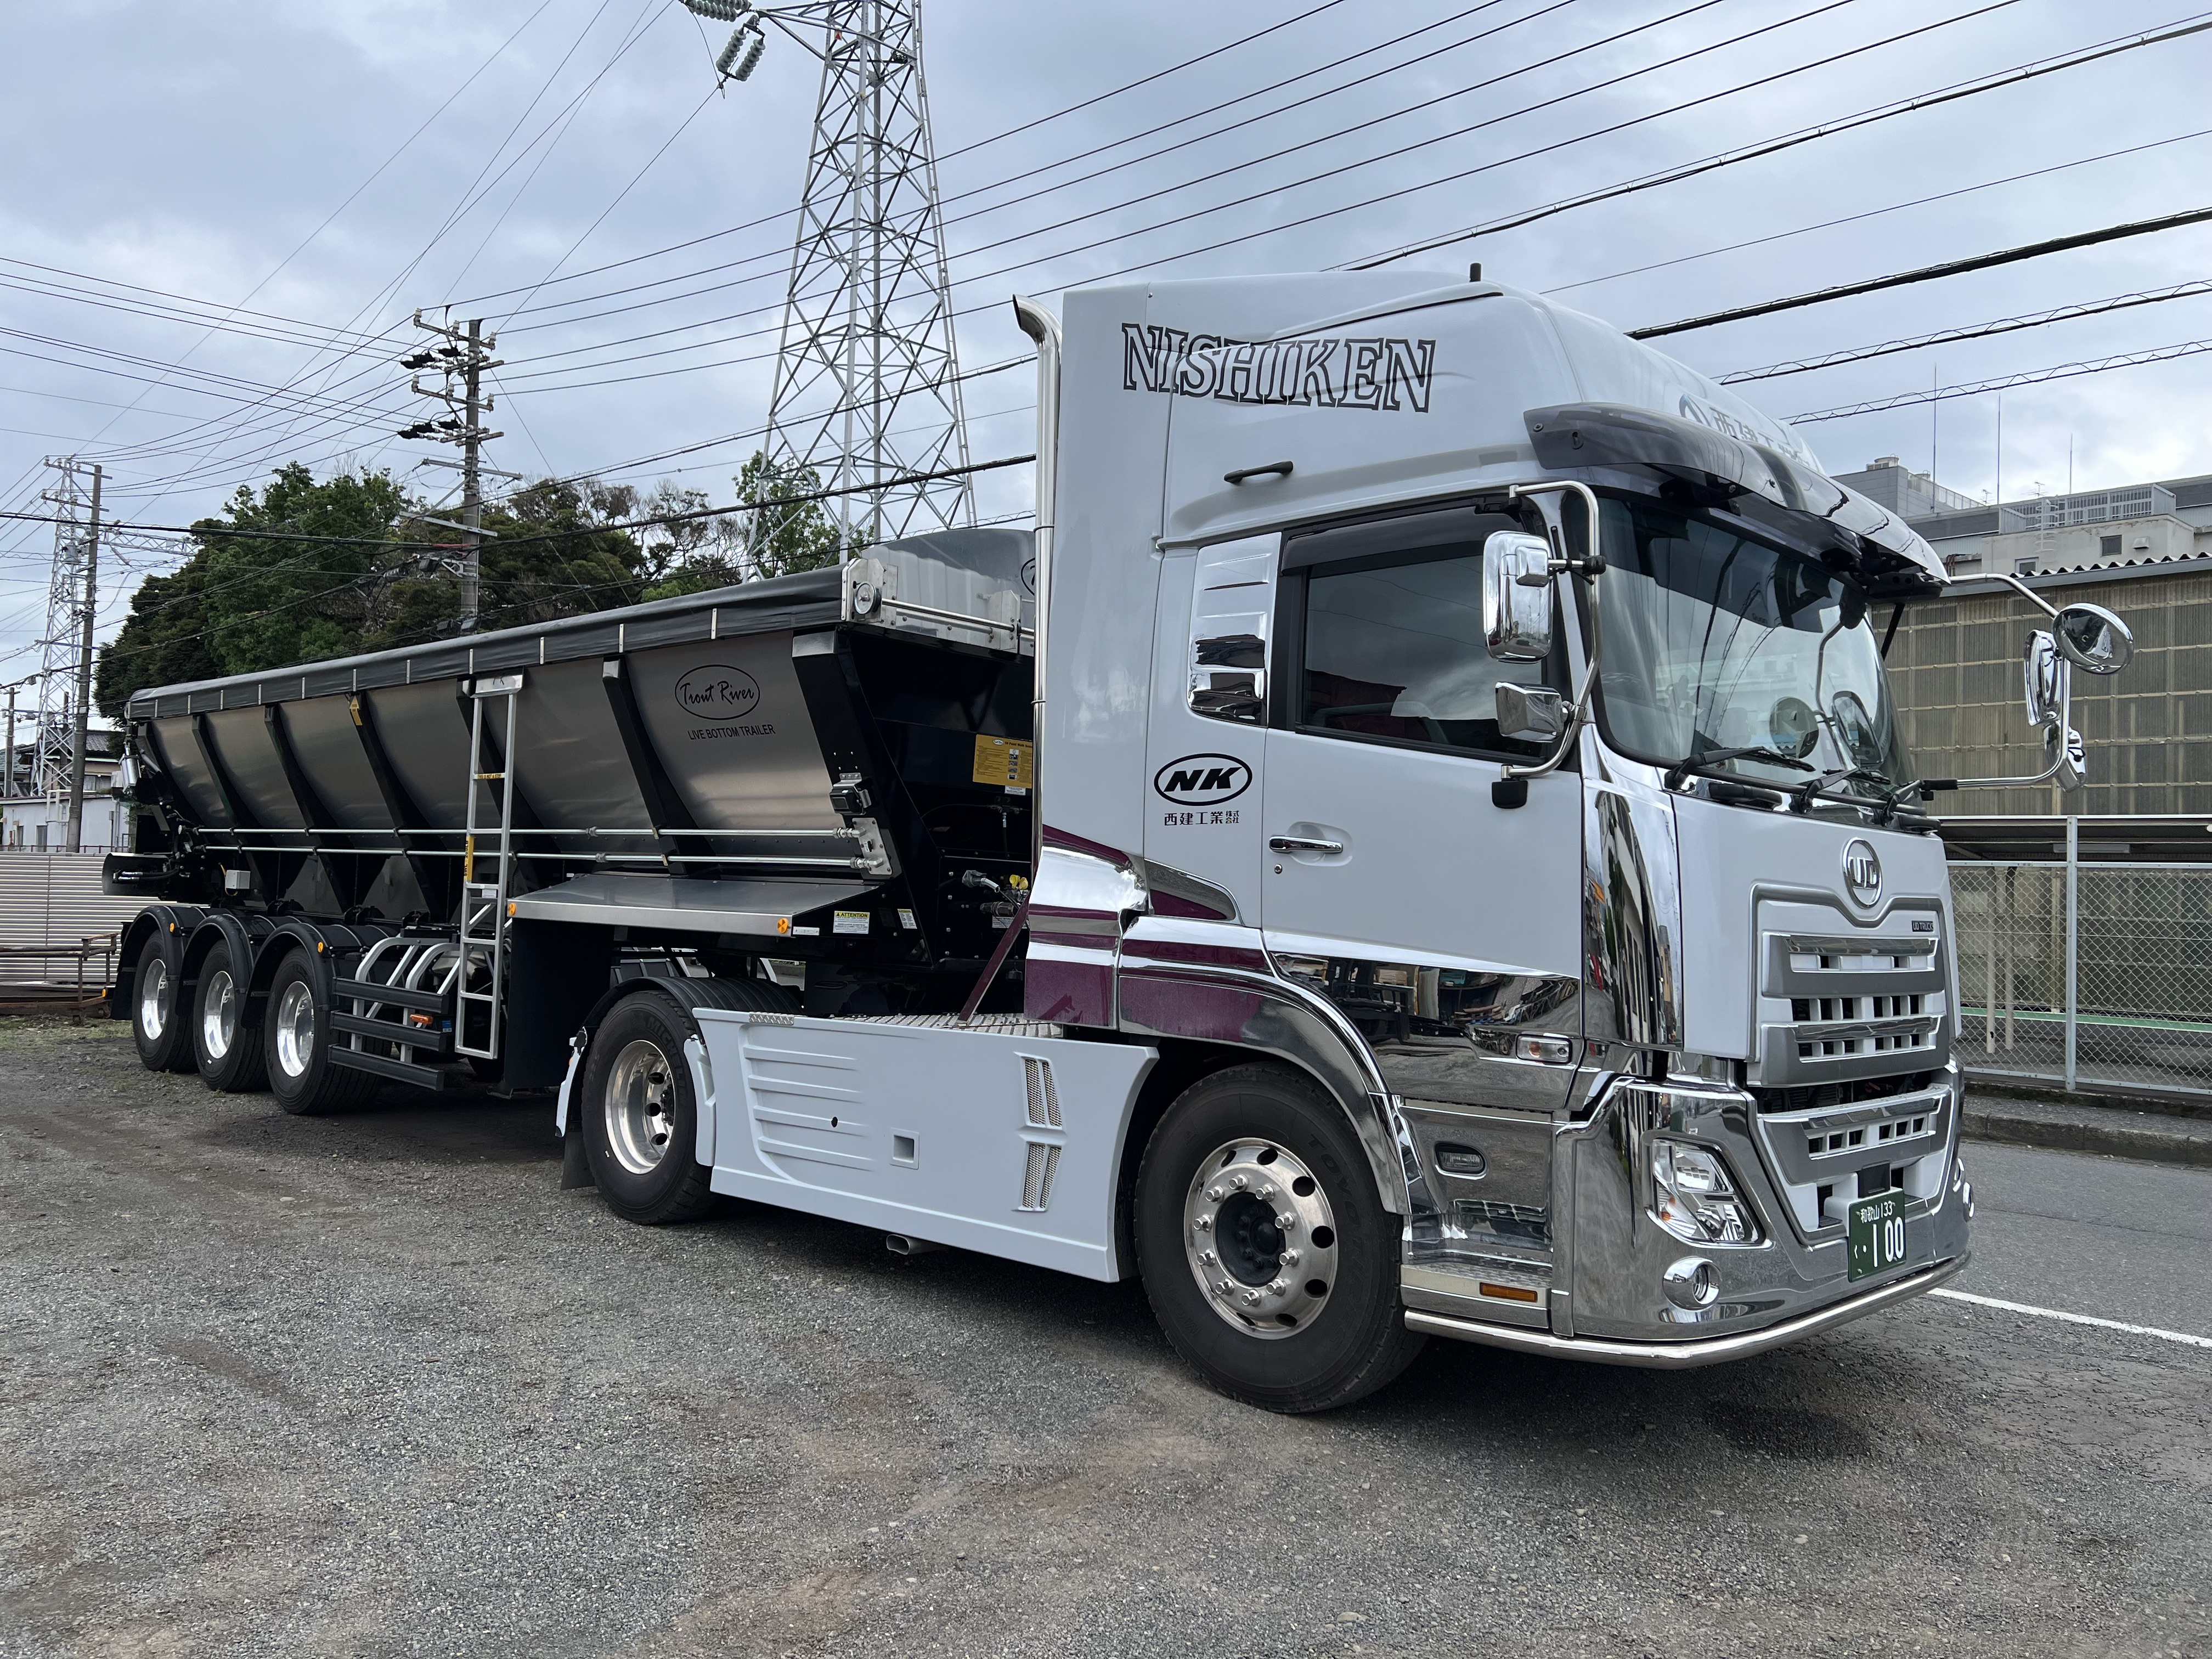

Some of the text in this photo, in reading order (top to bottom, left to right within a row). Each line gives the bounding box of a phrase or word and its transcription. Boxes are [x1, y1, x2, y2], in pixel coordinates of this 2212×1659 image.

[1121, 323, 1436, 413] NISHIKEN
[680, 680, 755, 706] Trout River
[687, 724, 776, 740] LIVE BOTTOM TRAILER
[1163, 766, 1243, 792] NK
[647, 1016, 686, 1104] MICHELIN
[1308, 1133, 1361, 1227] TOYO
